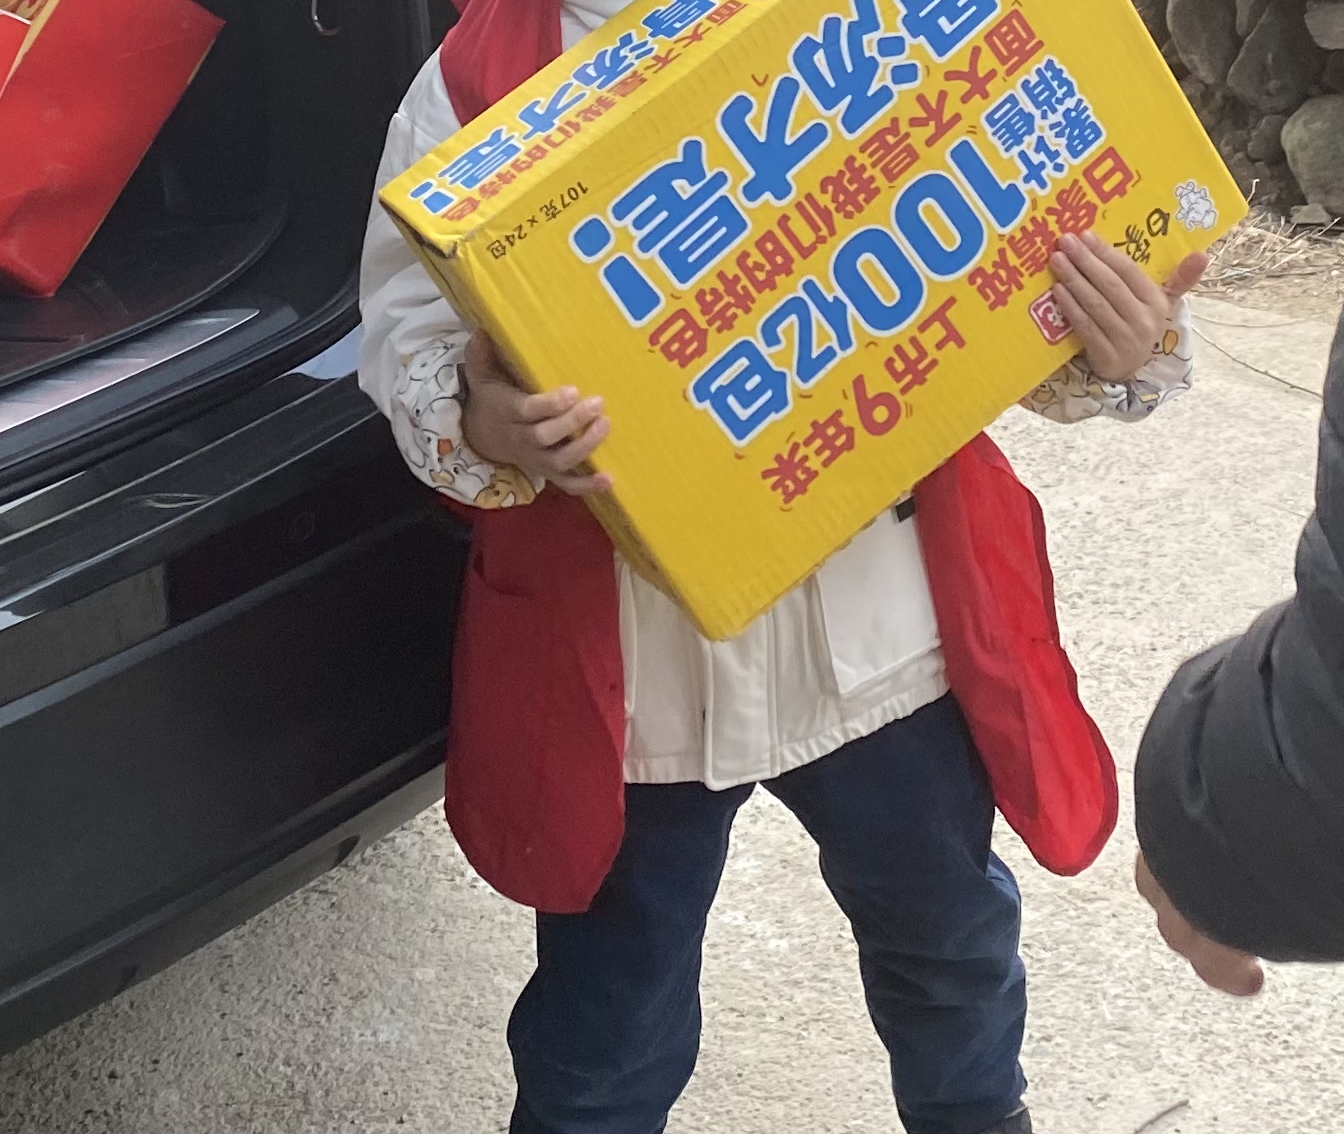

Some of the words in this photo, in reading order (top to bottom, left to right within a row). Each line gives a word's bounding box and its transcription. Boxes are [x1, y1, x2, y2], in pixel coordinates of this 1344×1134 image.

[444, 0, 744, 220] 面大不是我们的特色
[649, 10, 1042, 368] 面大不是我们的特色
[1112, 209, 1171, 265] 白象
